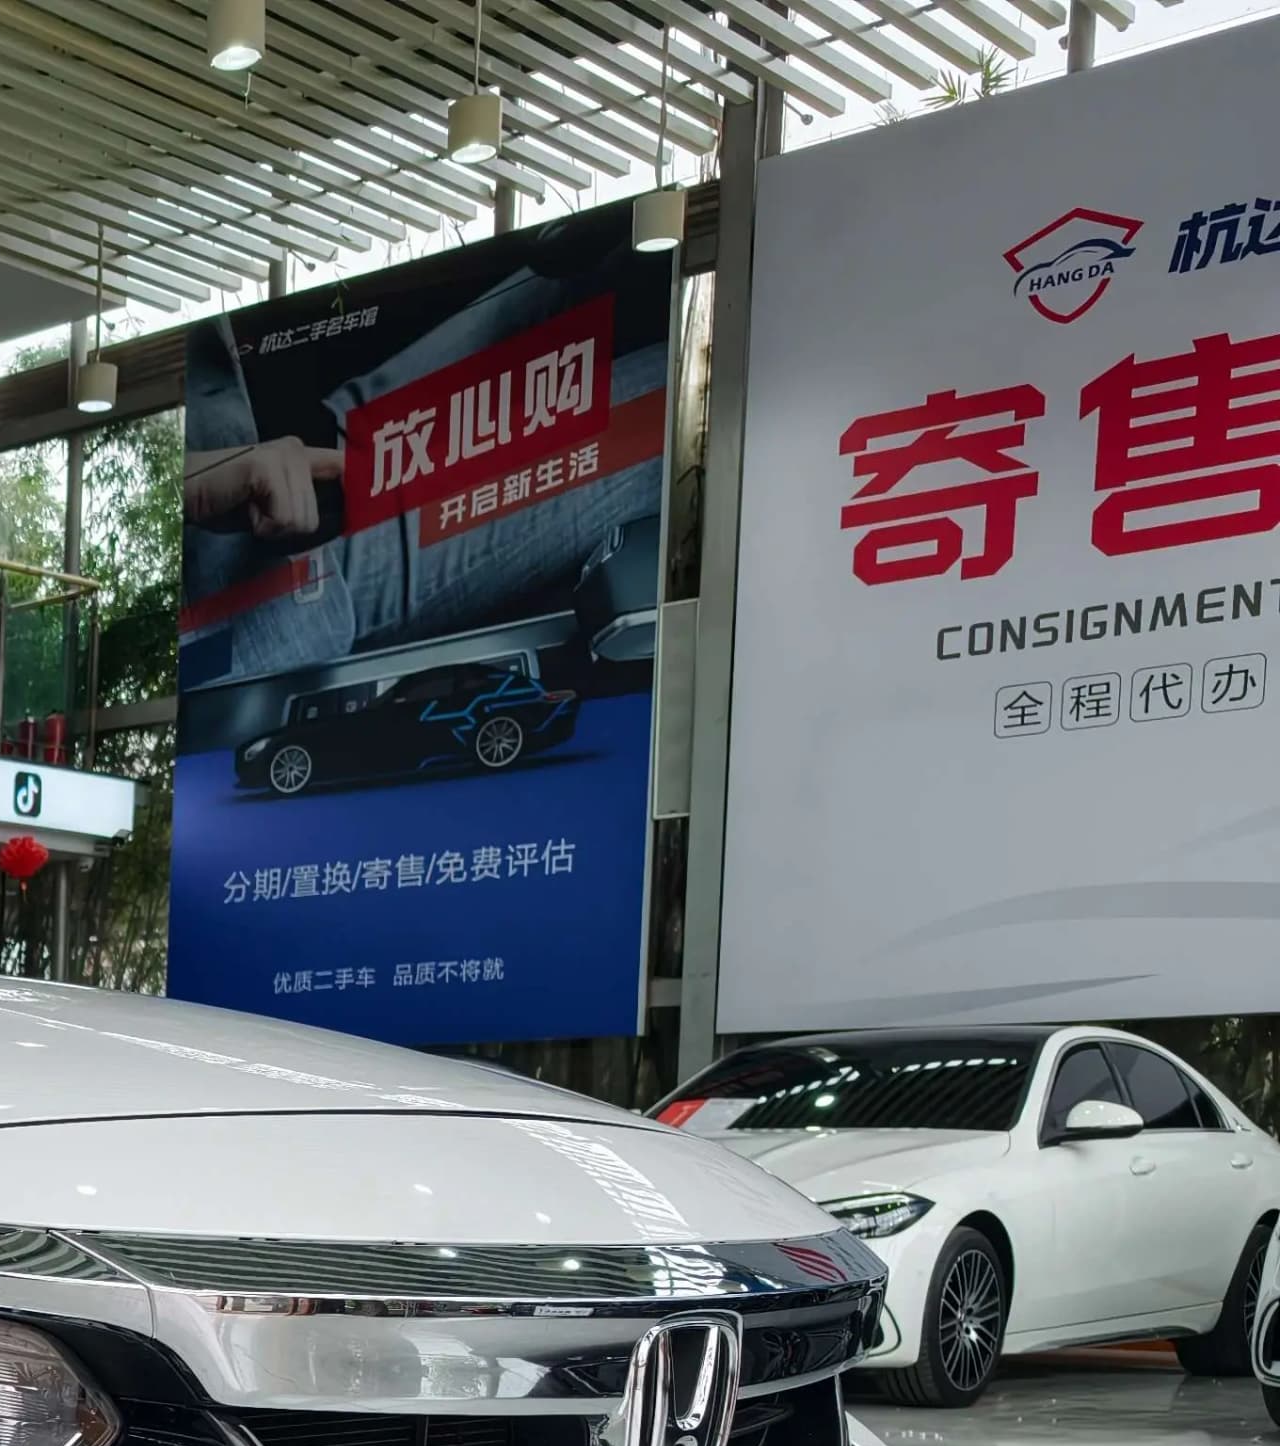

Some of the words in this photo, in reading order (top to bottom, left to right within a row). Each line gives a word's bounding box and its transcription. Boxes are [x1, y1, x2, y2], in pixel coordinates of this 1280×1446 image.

[1028, 267, 1084, 292] HANG
[1088, 261, 1115, 279] DA
[258, 305, 379, 355] 杭达二手名车馆
[370, 336, 596, 498] 放心购
[438, 441, 600, 530] 开启新生活
[838, 333, 1280, 587] 寄售
[1003, 663, 1256, 729] 全程代办
[223, 837, 576, 904] 分期/置换/寄售/免费评估
[273, 967, 376, 994] 优质二手车
[392, 957, 505, 987] 品质不将就
